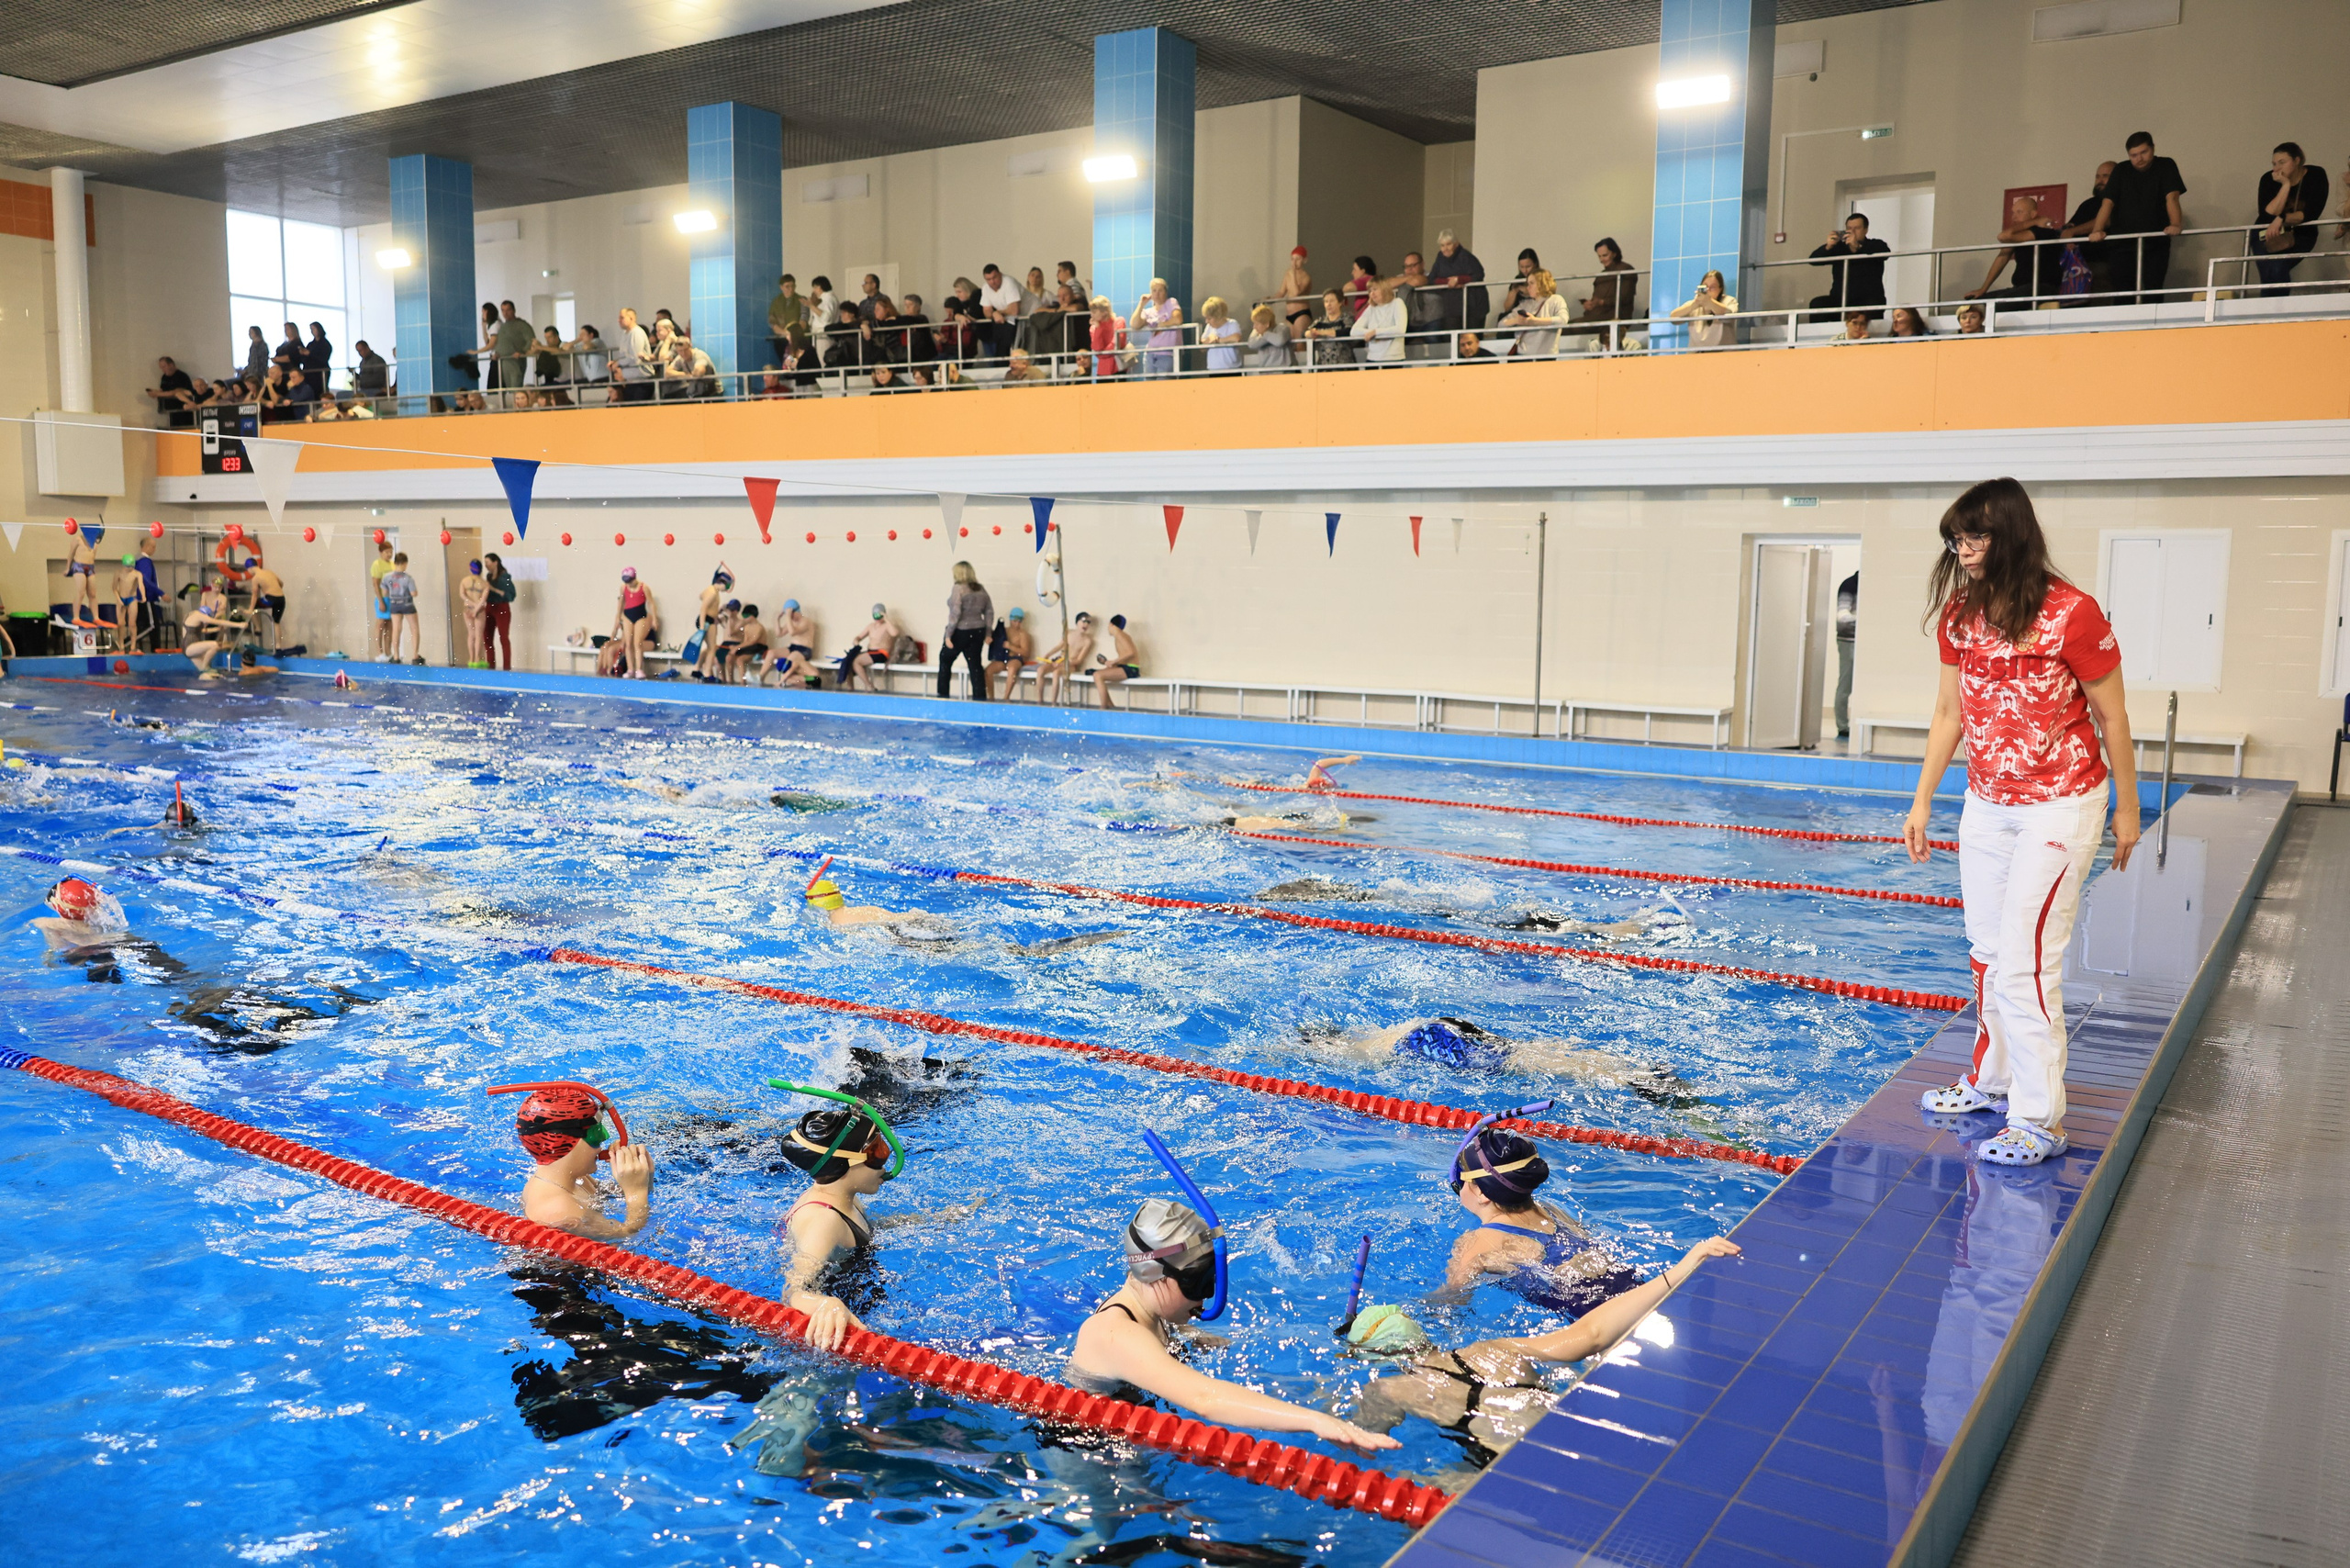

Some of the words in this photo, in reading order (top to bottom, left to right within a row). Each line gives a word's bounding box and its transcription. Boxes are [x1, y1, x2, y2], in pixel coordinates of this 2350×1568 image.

[1864, 129, 1891, 138] ЫХОД
[1785, 498, 1816, 506] ЫХОД
[84, 633, 93, 645] 6
[1959, 653, 2042, 679] USSIA
